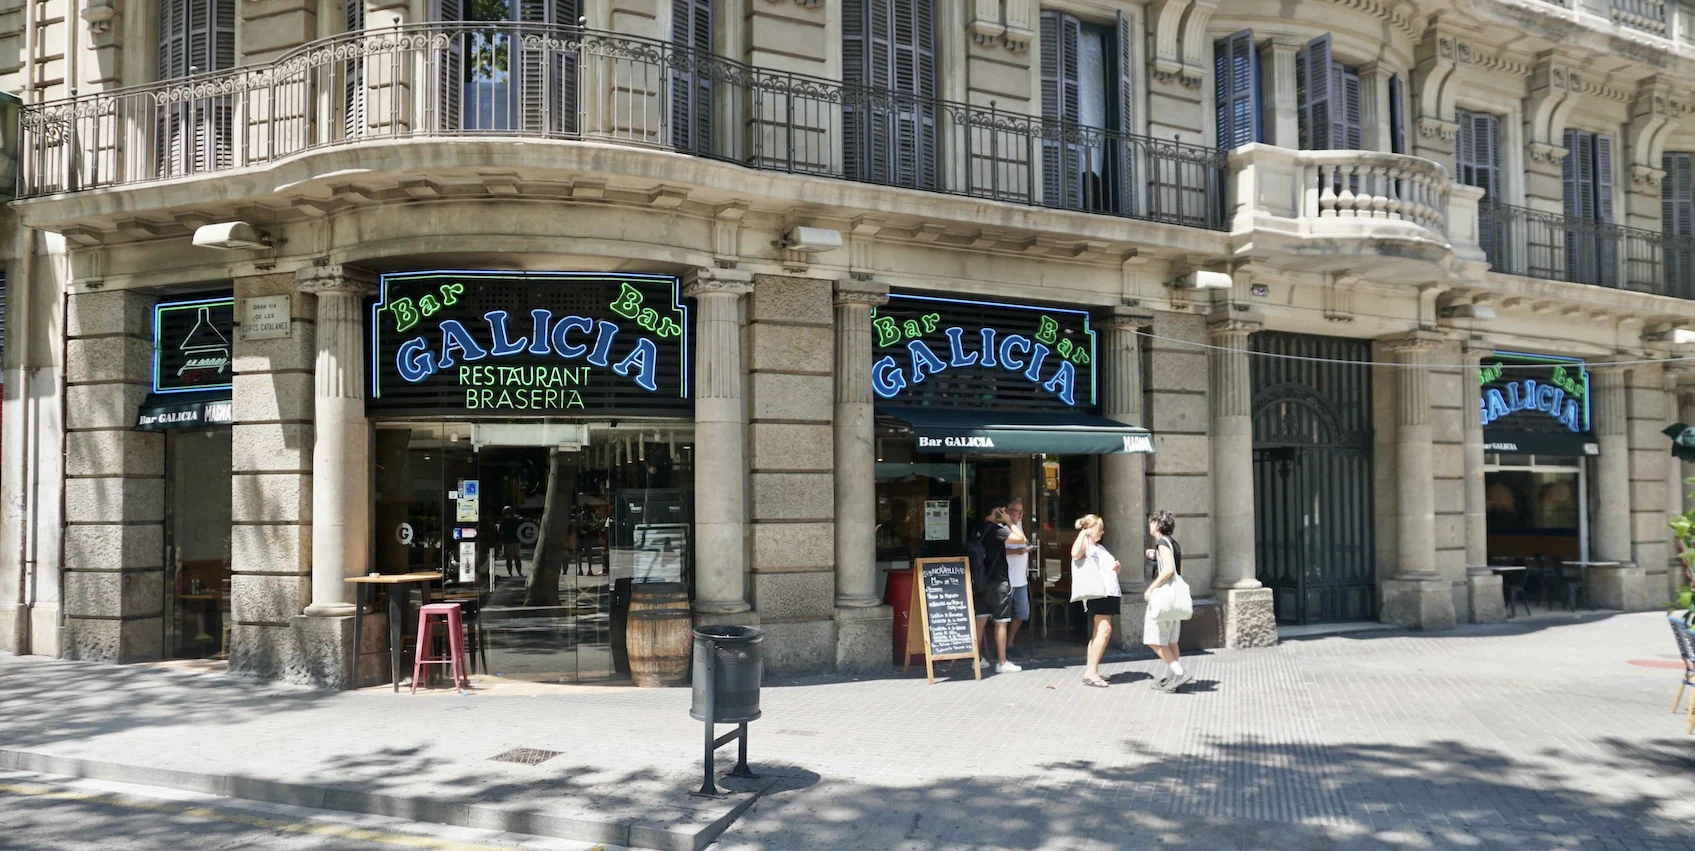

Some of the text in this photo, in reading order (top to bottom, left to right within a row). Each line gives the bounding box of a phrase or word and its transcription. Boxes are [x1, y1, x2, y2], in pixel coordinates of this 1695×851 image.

[390, 283, 464, 333] Bar
[609, 282, 682, 338] Bar
[260, 322, 288, 331] CATALANES
[873, 312, 941, 348] Bar
[396, 309, 658, 392] GALICIA
[1034, 314, 1090, 364] Bar
[459, 365, 591, 388] RESTAURANT
[871, 326, 1076, 406] GALICIA
[1479, 362, 1503, 386] ar
[466, 388, 585, 409] BRASERIA
[139, 411, 197, 425] Bar GALICIA
[204, 403, 231, 422] MAGNA
[919, 436, 995, 448] Bar GALICIA
